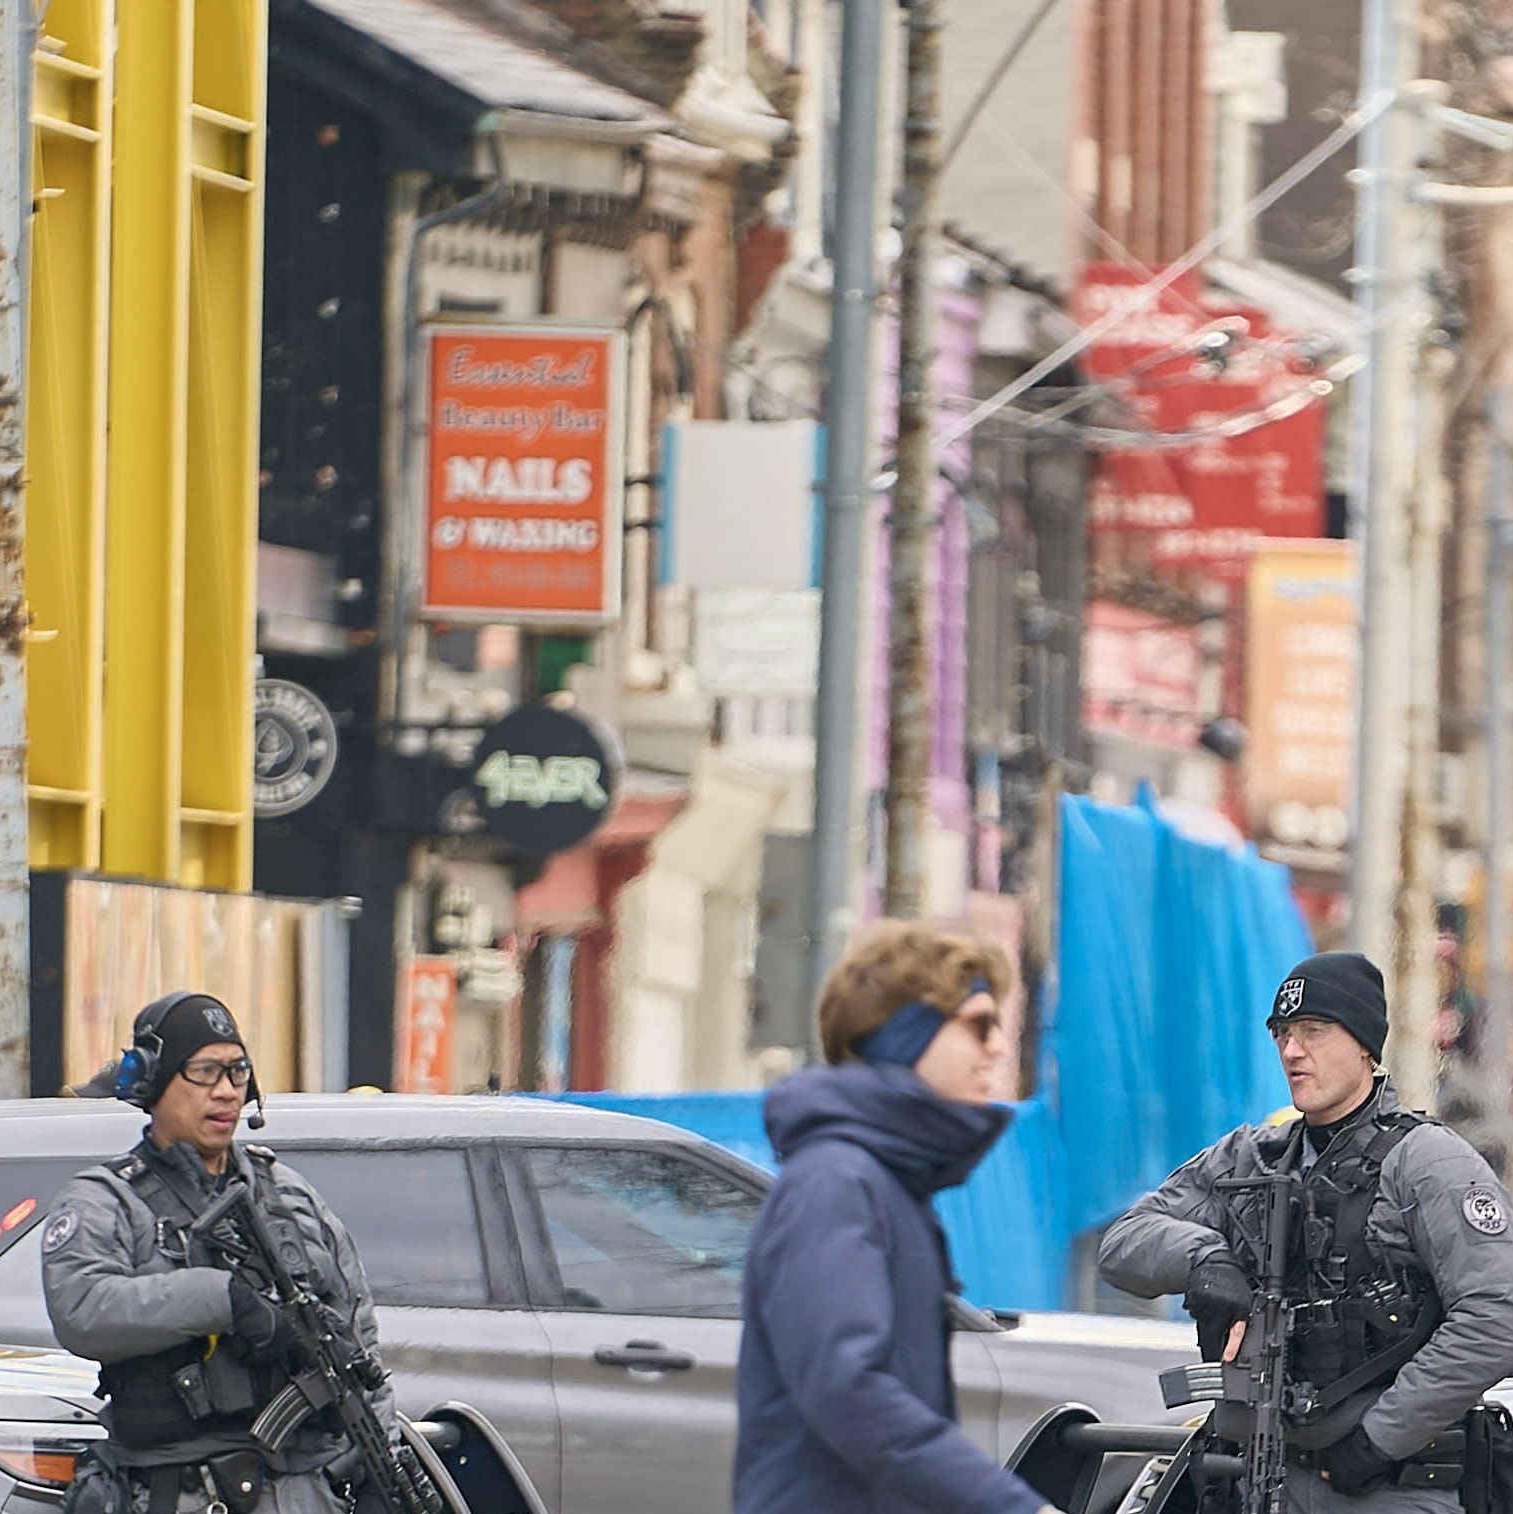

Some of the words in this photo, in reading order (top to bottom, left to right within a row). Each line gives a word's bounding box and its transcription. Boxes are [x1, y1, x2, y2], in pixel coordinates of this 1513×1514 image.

[440, 397, 552, 445] Beauty
[554, 401, 605, 436] Bar
[444, 455, 593, 506] NAILS
[469, 516, 599, 554] WAXING
